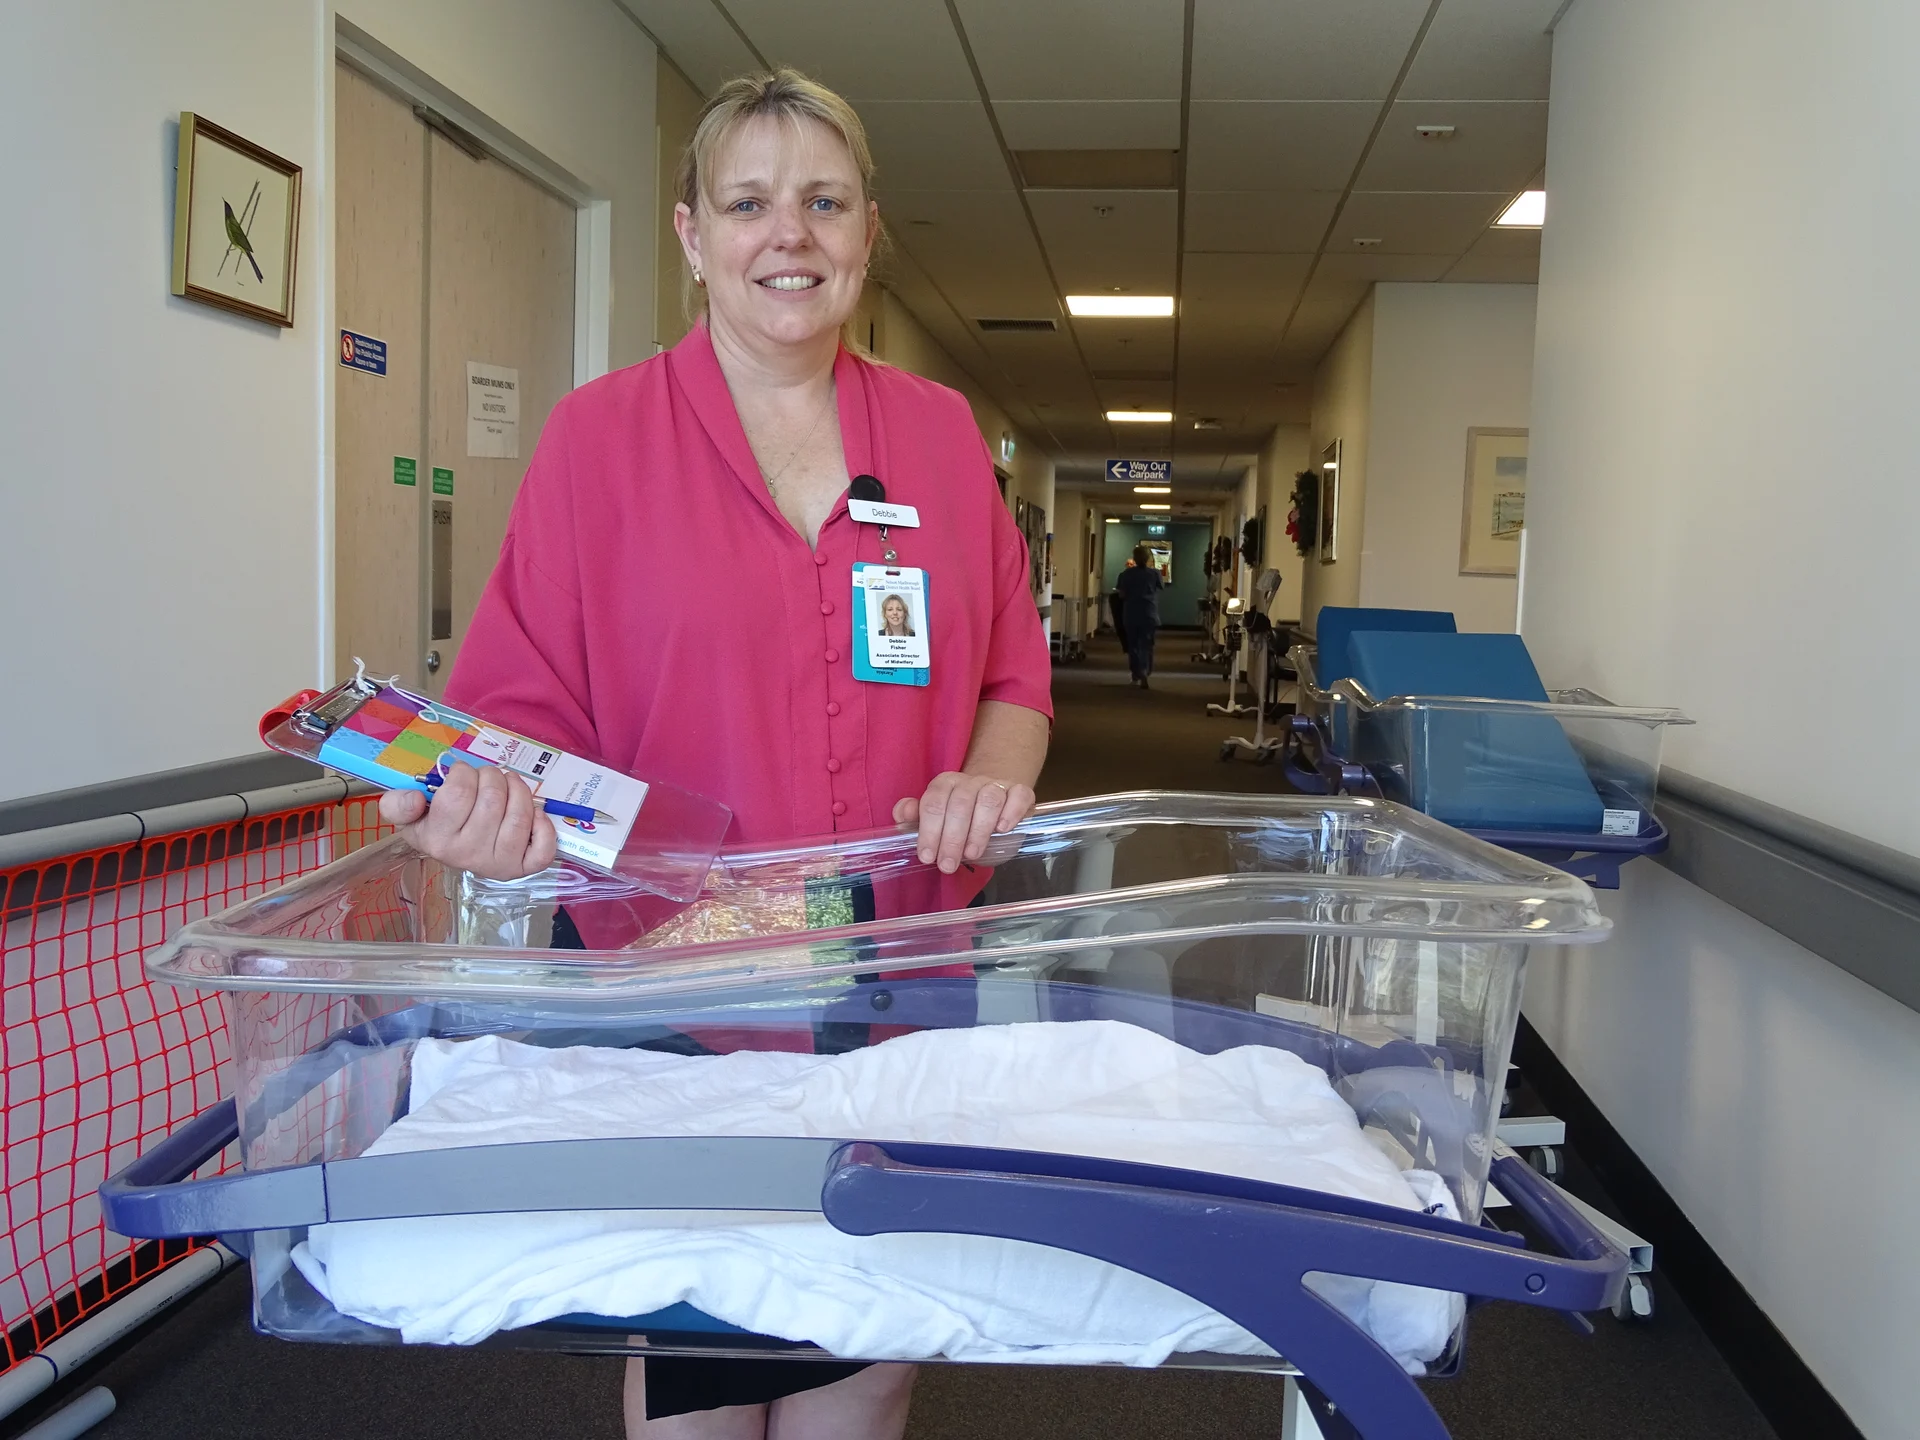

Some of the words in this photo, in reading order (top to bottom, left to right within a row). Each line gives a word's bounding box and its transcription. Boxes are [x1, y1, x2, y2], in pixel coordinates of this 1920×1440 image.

[471, 375, 491, 387] BOARDER
[490, 378, 504, 389] MUMS
[504, 381, 516, 391] ONLY
[482, 402, 489, 412] NO
[489, 404, 506, 414] VISITORS
[1129, 461, 1148, 473] Way
[1150, 461, 1167, 471] Out
[1128, 470, 1164, 480] Carpark
[433, 509, 452, 525] PUSH
[872, 508, 898, 519] Debbie
[505, 738, 520, 753] Child
[585, 772, 603, 789] Book
[579, 845, 599, 857] Book
